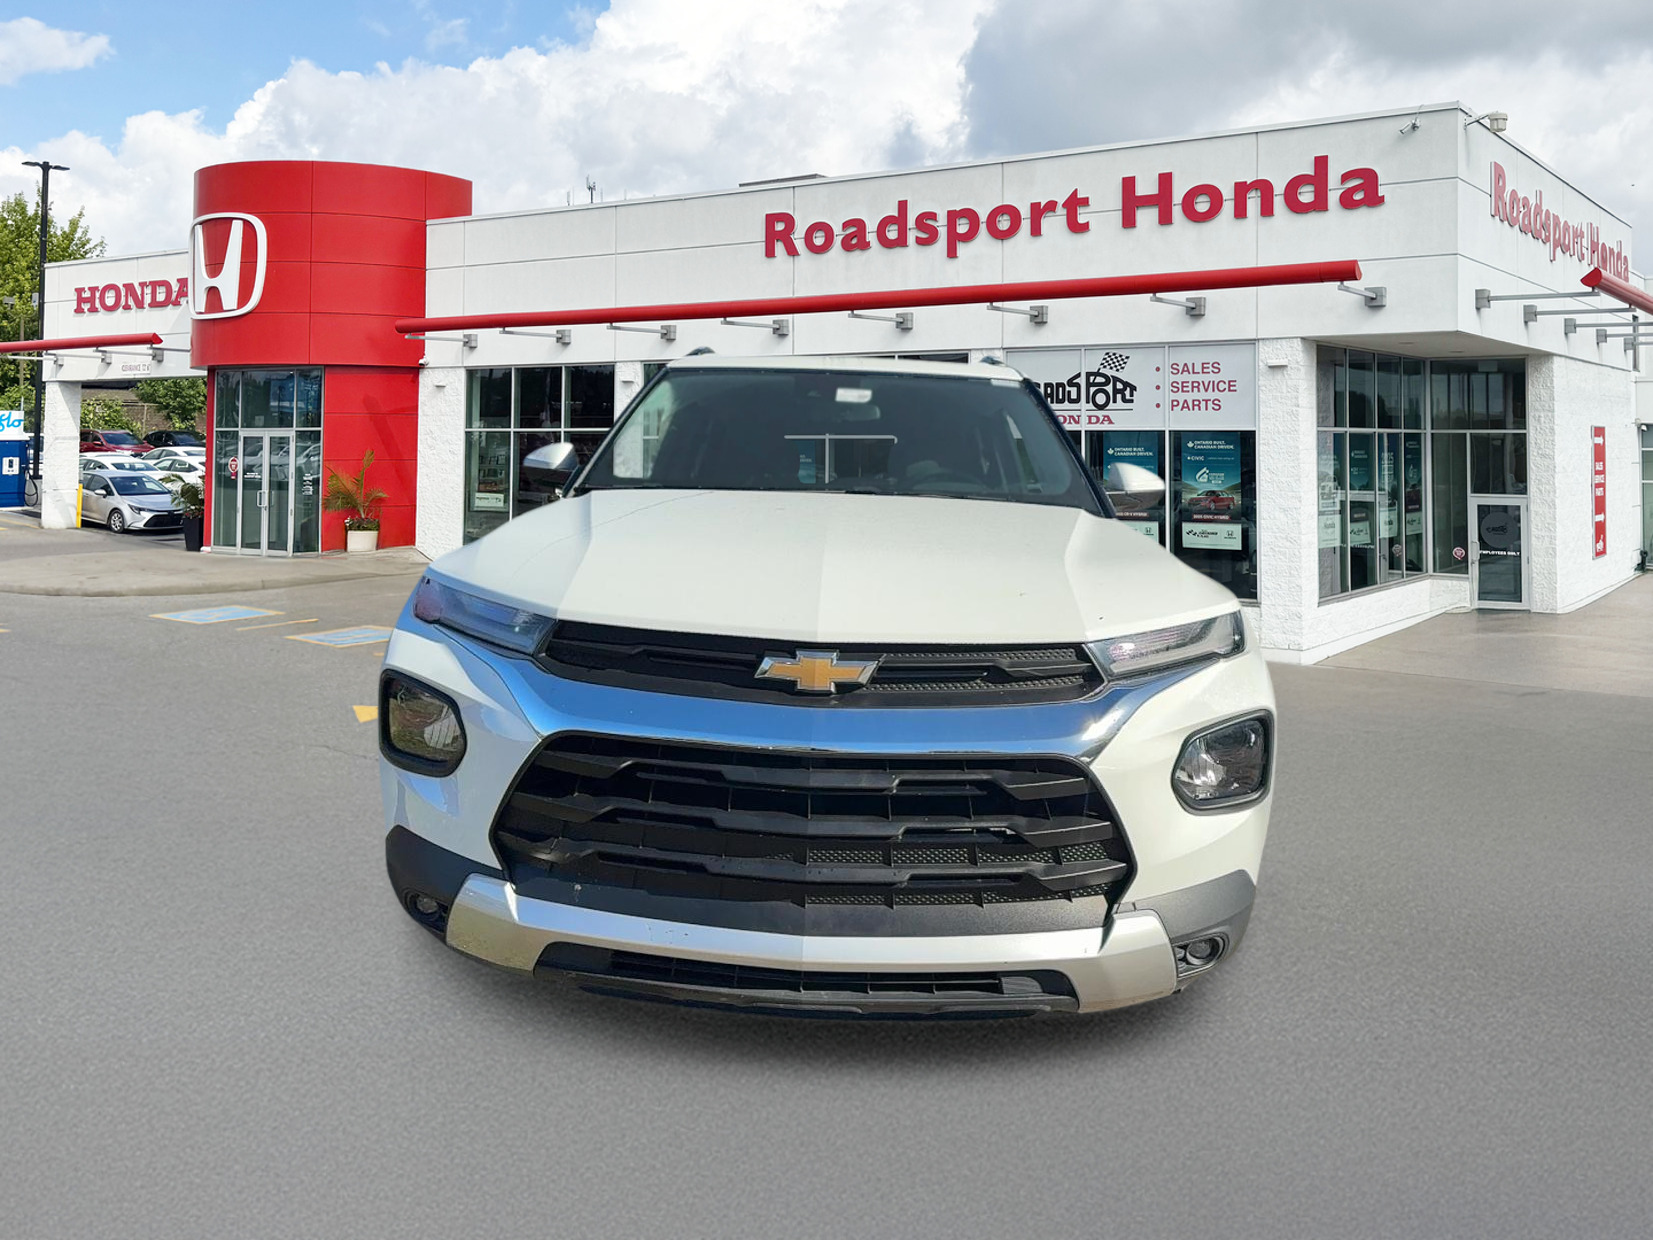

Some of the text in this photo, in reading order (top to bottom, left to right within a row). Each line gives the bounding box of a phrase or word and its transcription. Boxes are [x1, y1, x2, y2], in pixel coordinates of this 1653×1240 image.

[765, 154, 1385, 258] Roadsport Honda
[1490, 161, 1629, 283] Roadsport Honda
[74, 277, 188, 314] HONDA
[1170, 361, 1221, 375] SALES
[1170, 380, 1237, 393] SERVICE
[1170, 398, 1222, 411] PARTS
[1056, 414, 1114, 425] ONDA
